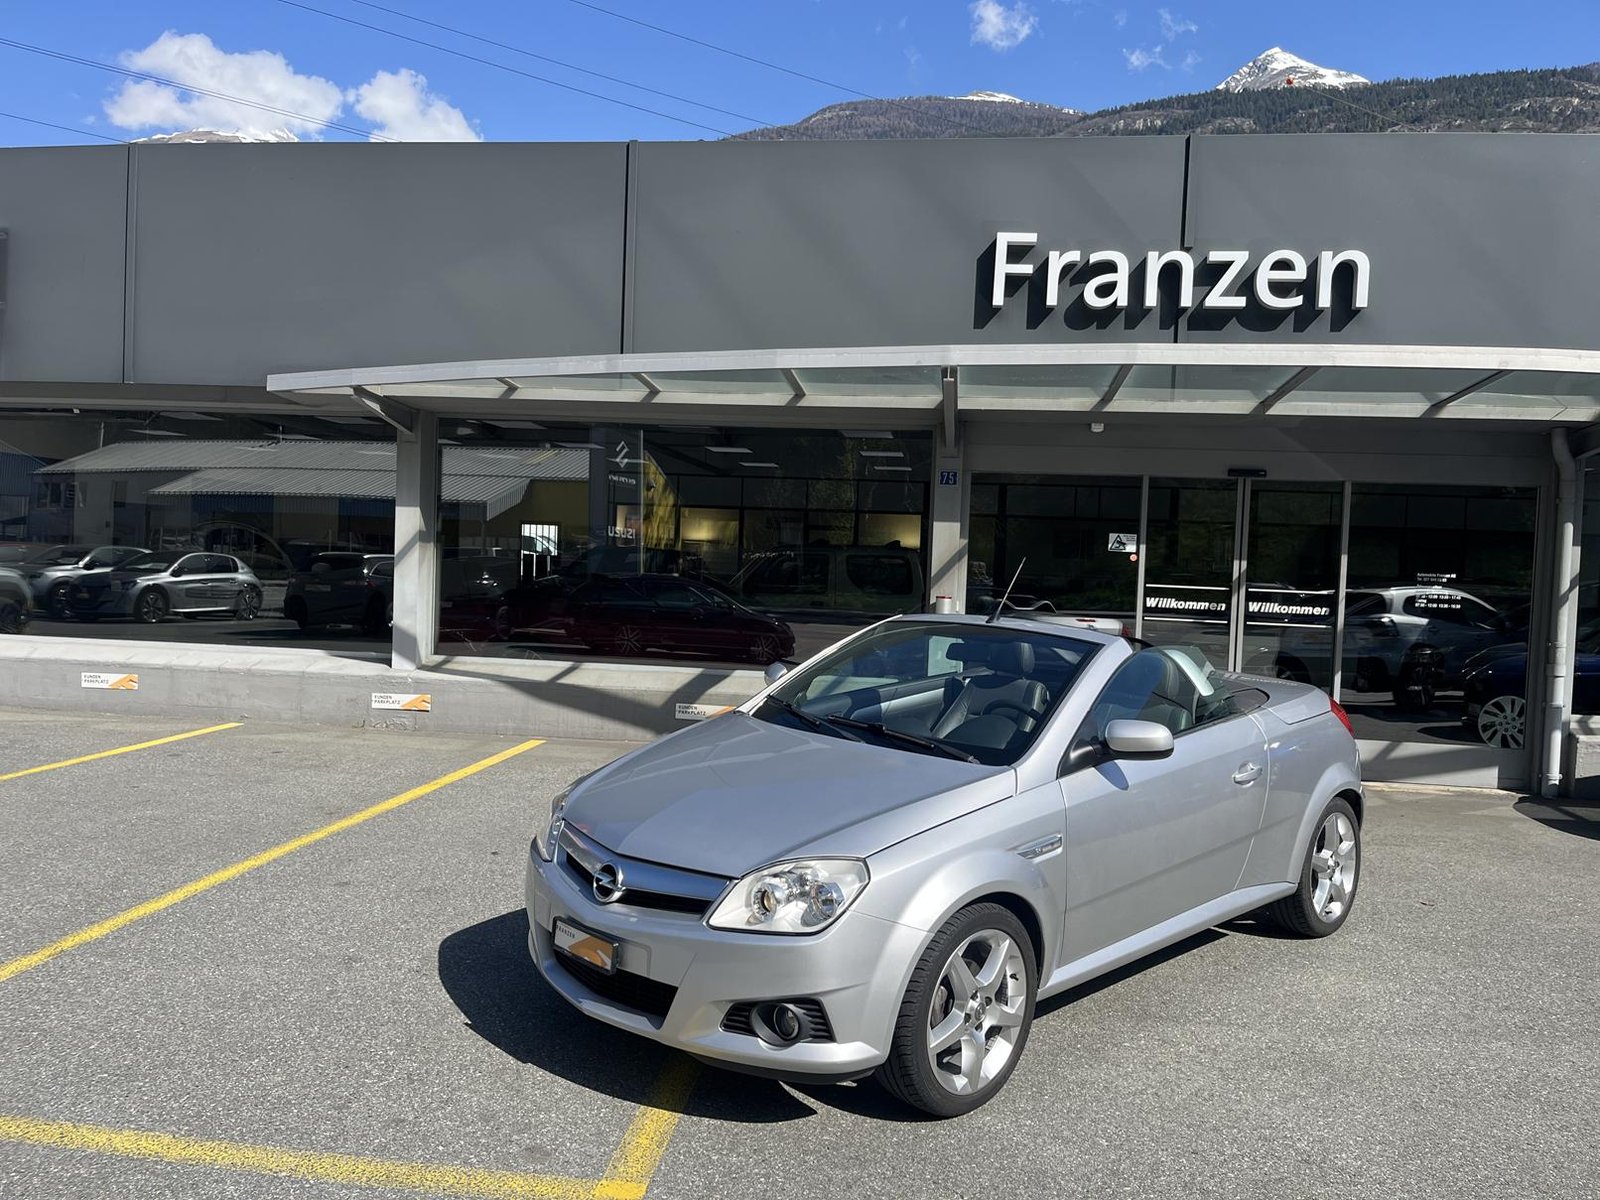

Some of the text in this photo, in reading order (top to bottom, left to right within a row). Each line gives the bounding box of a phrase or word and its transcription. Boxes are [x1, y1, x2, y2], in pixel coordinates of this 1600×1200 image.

[992, 232, 1370, 309] Franzen
[942, 472, 956, 484] 75
[1145, 597, 1226, 611] Willkommen
[1248, 601, 1330, 616] Willkommen
